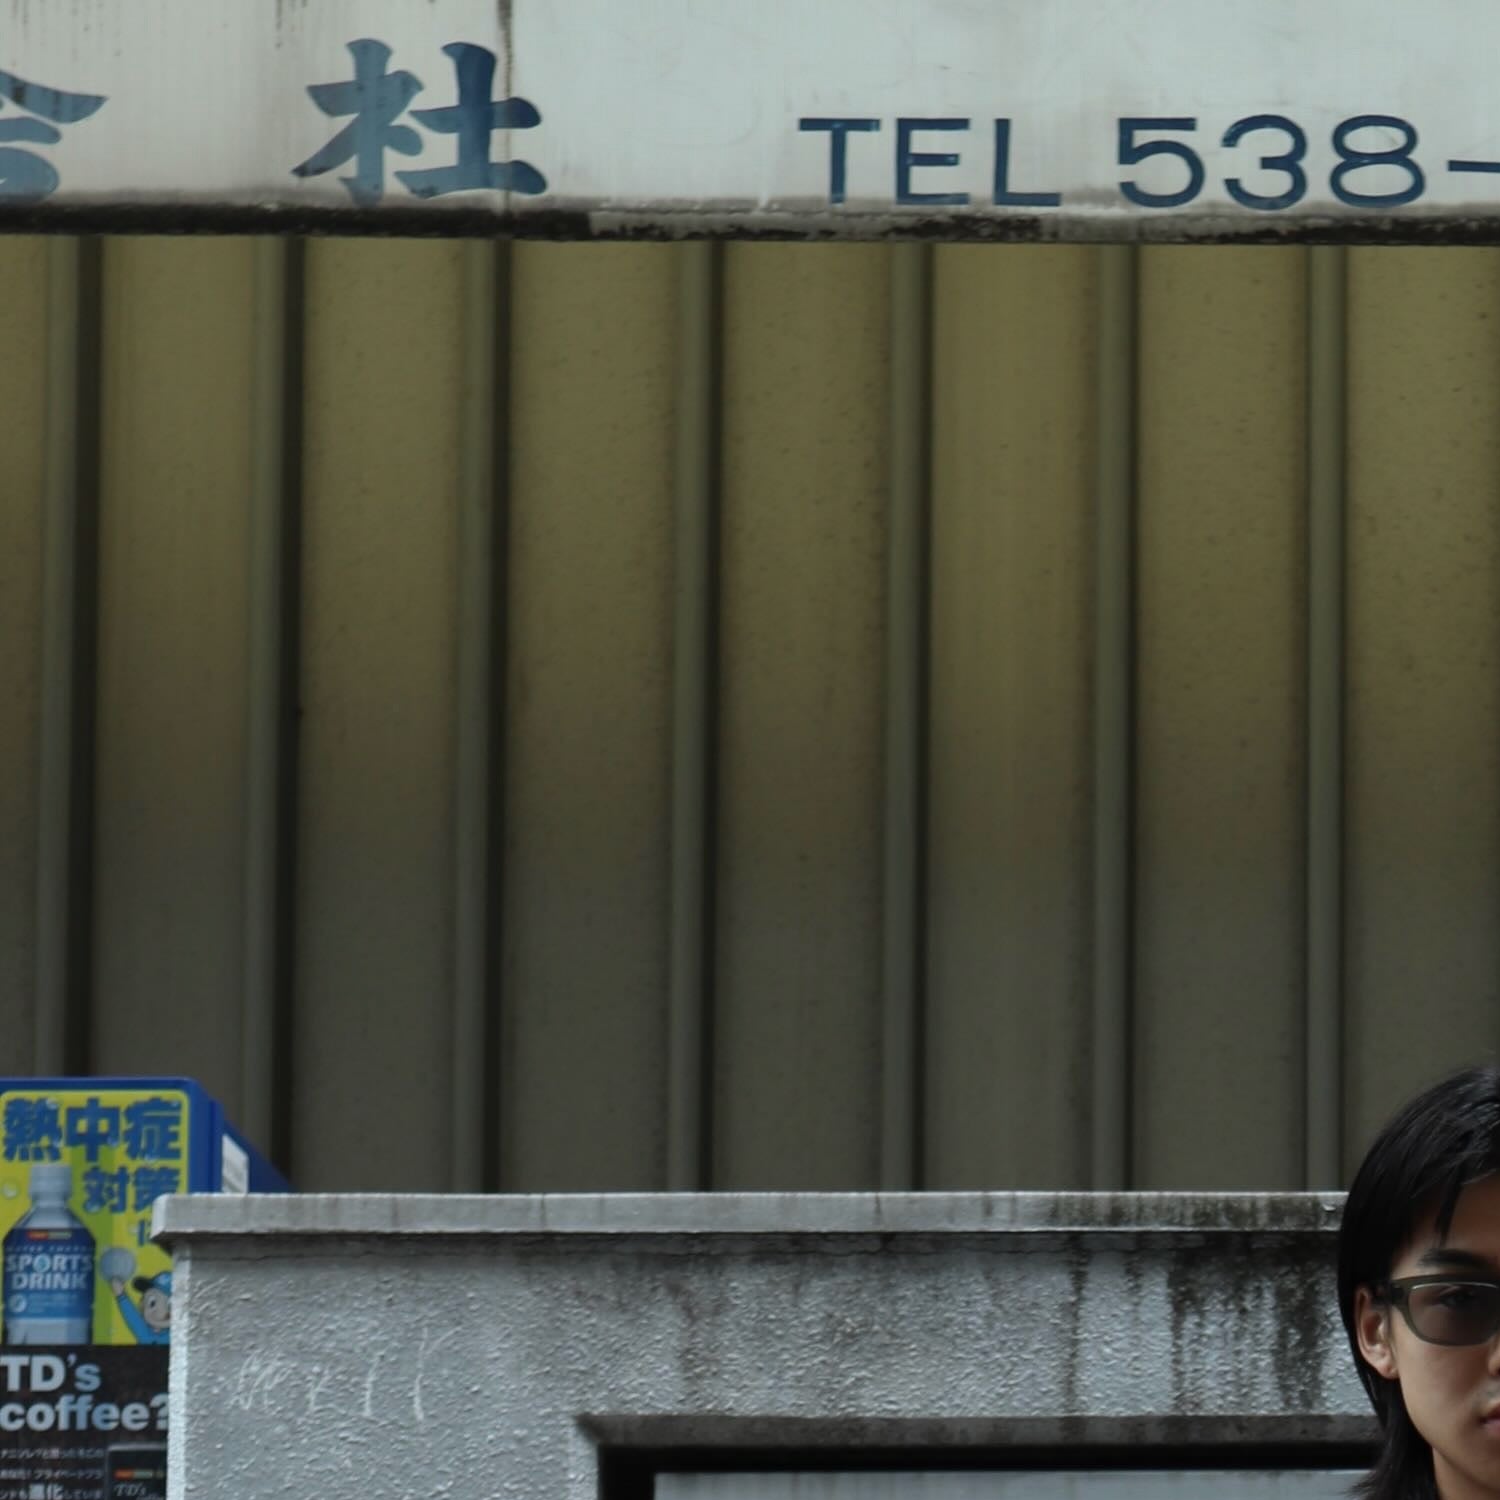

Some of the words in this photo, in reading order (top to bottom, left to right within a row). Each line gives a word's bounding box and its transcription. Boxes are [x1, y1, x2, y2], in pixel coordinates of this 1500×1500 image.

[798, 116, 1061, 207] TEL
[3, 1096, 182, 1162] 熱中症
[6, 1253, 92, 1272] SPORTS
[11, 1272, 87, 1290] DRINK
